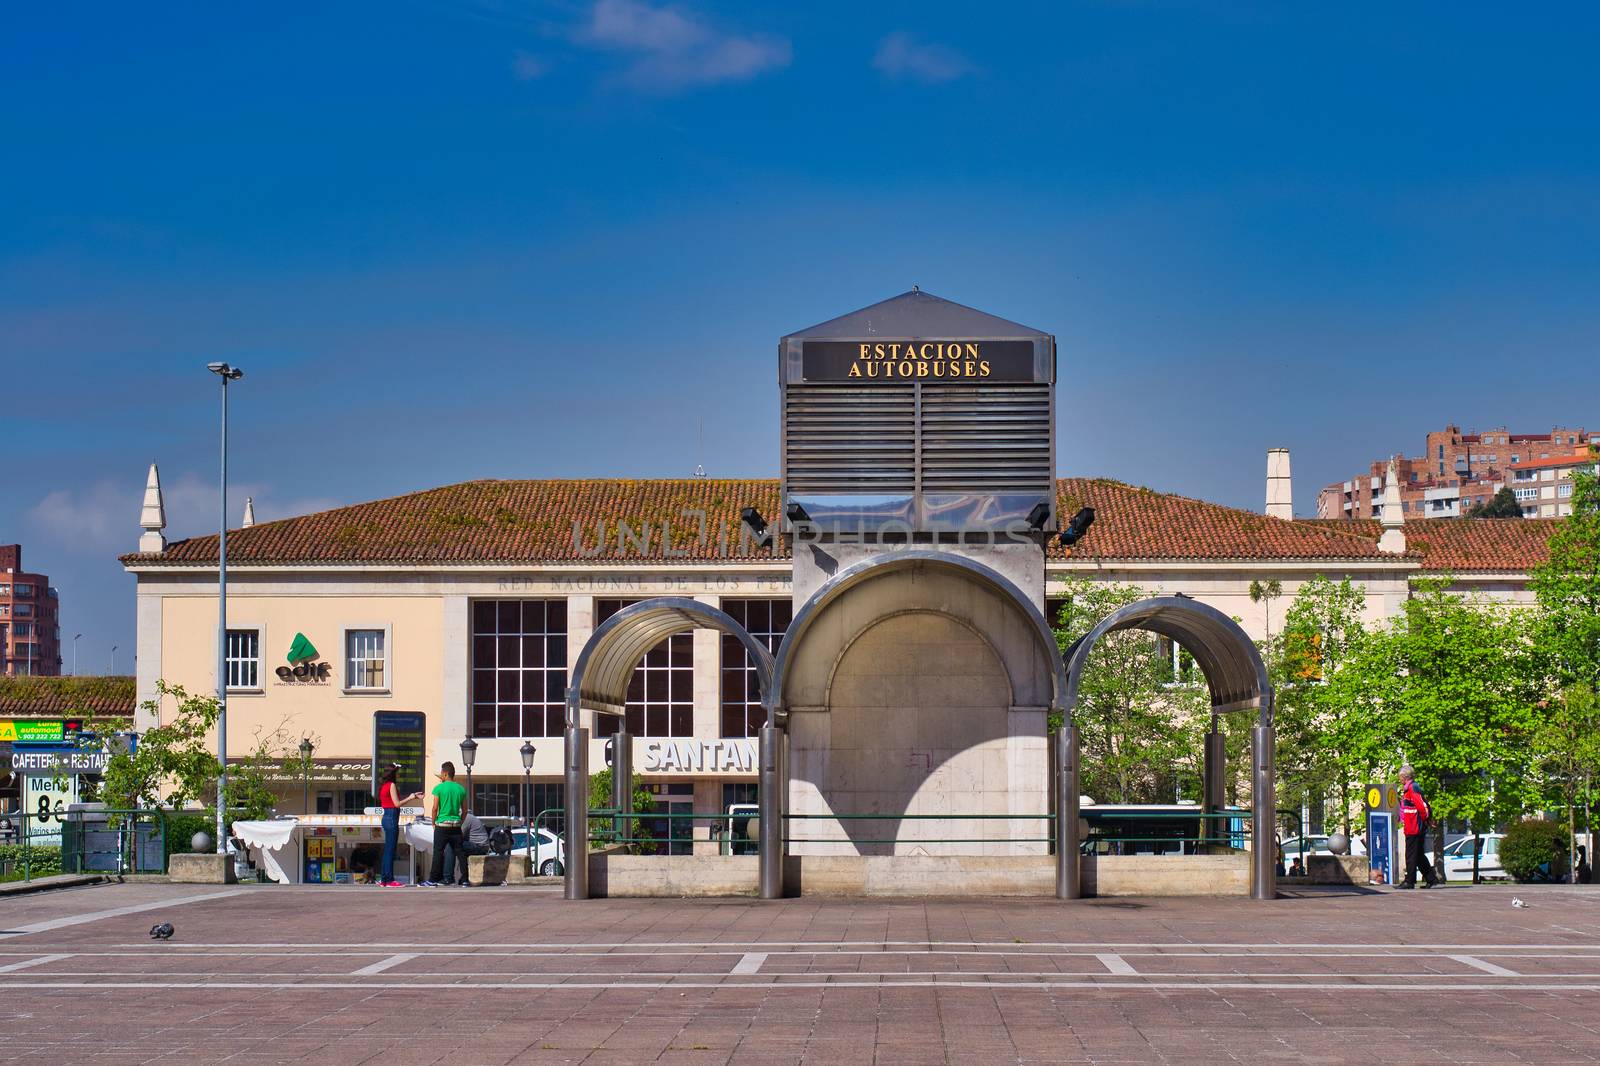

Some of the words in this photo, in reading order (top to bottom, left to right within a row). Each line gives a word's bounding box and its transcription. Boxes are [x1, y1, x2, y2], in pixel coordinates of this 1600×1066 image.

[860, 344, 979, 360] ESTACION
[849, 361, 991, 377] AUTOBUSES
[498, 576, 534, 591] RED
[551, 576, 648, 591] NACIONAL
[664, 576, 687, 590] DE
[703, 576, 740, 590] LOS
